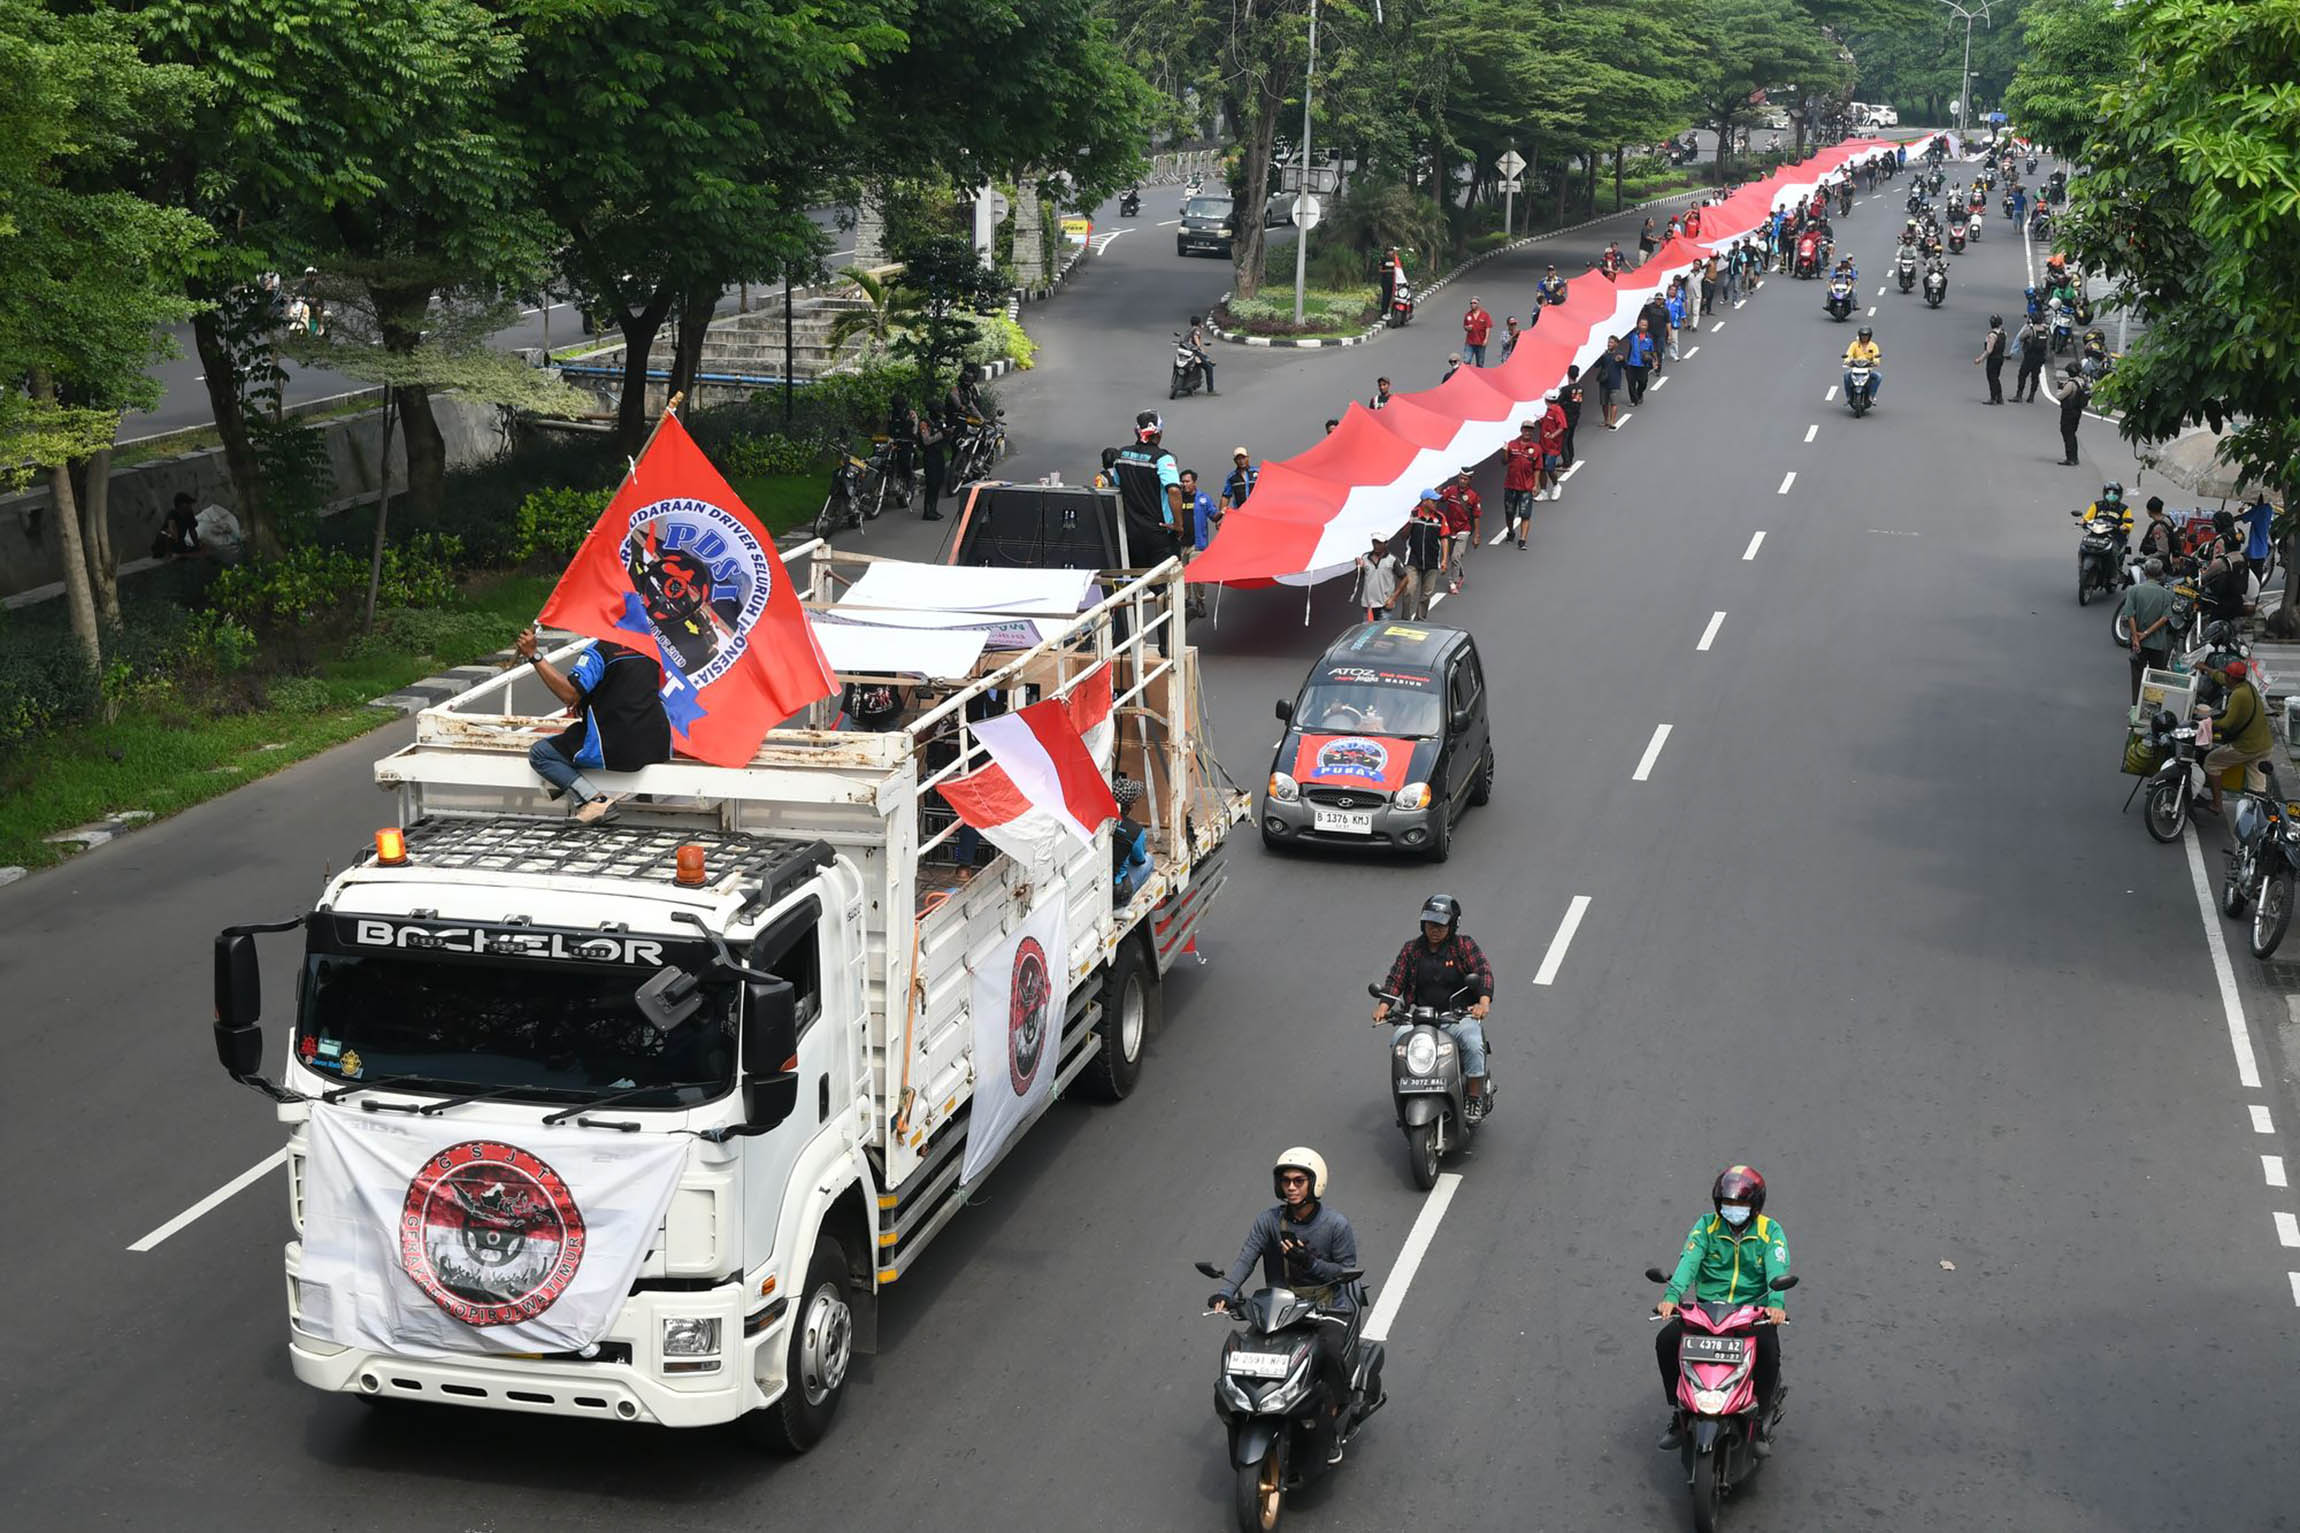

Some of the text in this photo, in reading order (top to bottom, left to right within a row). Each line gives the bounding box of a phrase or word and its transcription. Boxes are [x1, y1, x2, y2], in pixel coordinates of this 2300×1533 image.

[662, 523, 743, 603] PDSI
[709, 509, 757, 551] DRIVER
[741, 553, 769, 616] SELURUH
[1327, 667, 1376, 676] ATOZ
[1317, 812, 1370, 826] B 1376 KMJ
[548, 1237, 580, 1292] TIMUR
[1687, 1340, 1693, 1349] L
[1728, 1342, 1740, 1352] AZ
